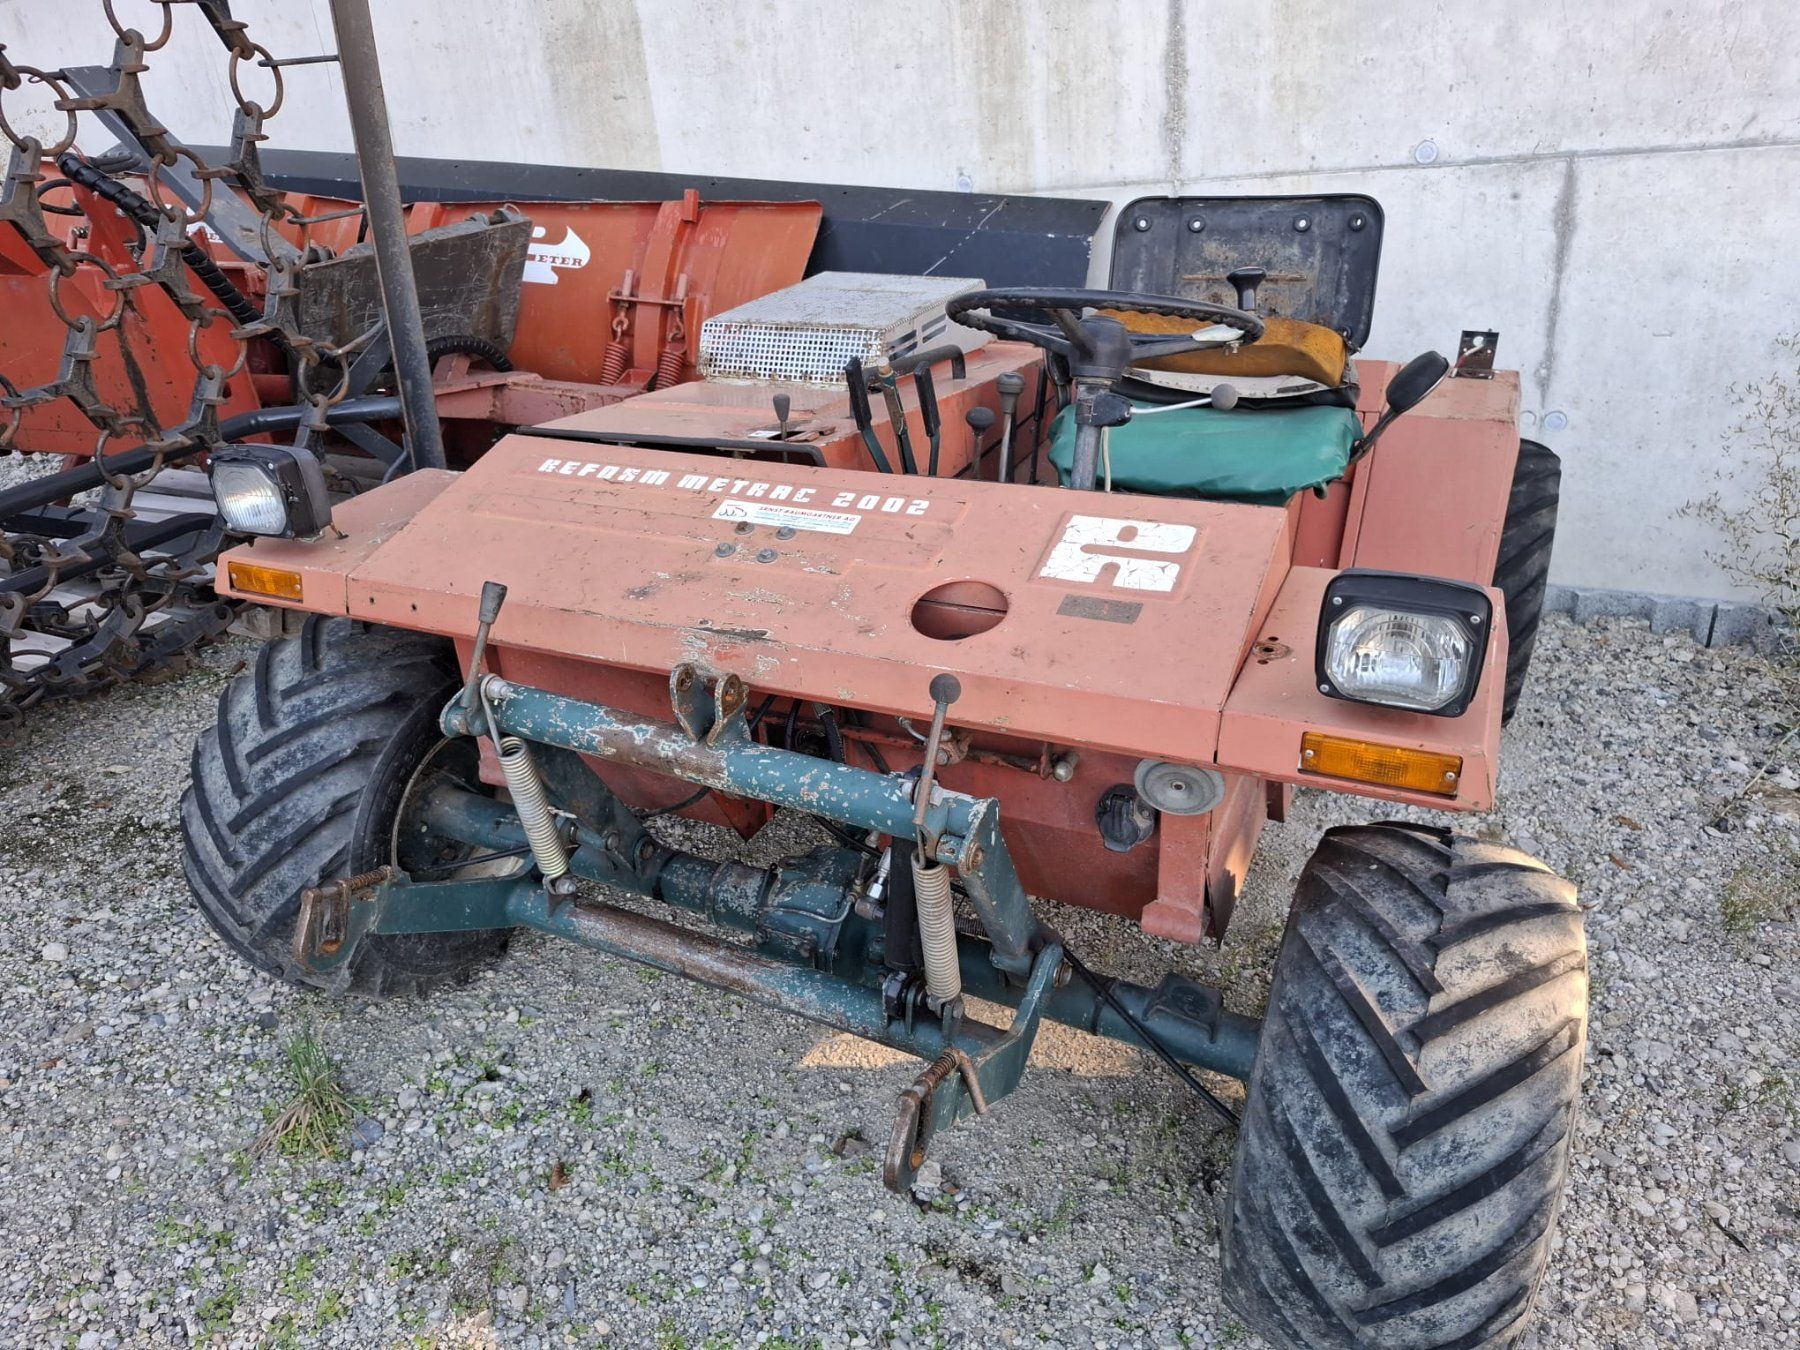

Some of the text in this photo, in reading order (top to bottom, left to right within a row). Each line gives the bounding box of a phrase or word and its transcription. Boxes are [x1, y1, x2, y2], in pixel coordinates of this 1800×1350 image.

[538, 458, 930, 516] REFORM METRAC 2002
